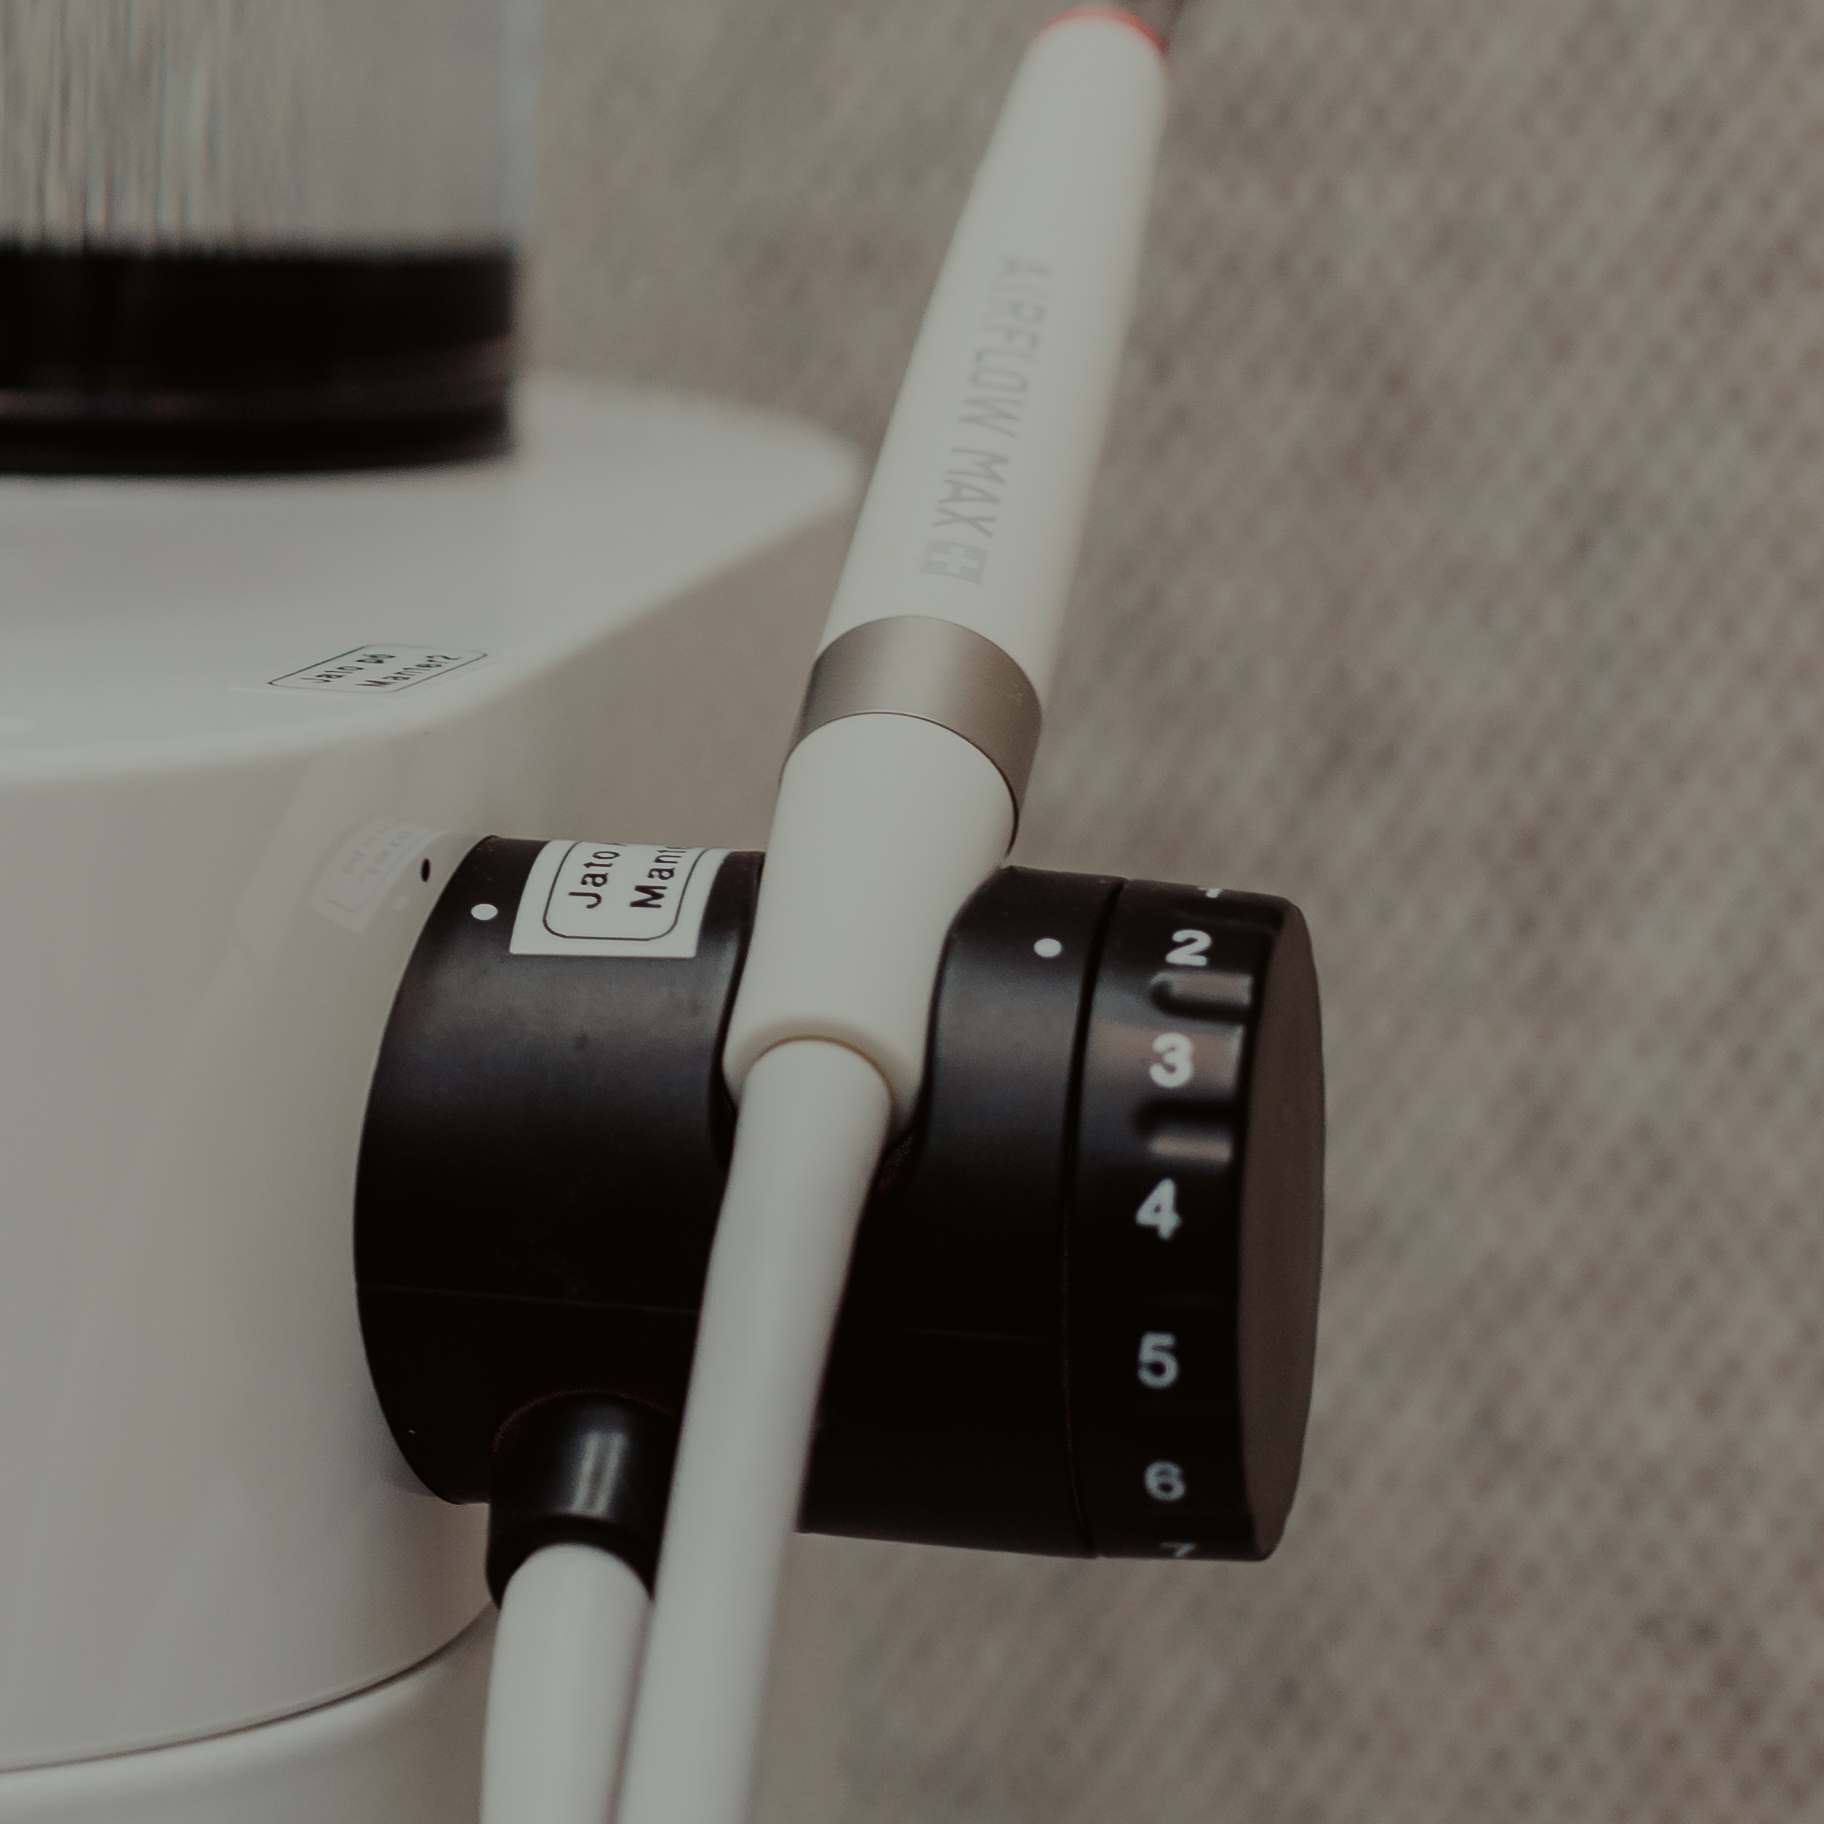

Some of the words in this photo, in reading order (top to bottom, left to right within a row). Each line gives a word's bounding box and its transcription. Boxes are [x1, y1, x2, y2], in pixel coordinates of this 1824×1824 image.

[959, 256, 1052, 439] AIRFLOW
[931, 447, 1011, 540] MAX
[568, 850, 621, 909] Jato
[629, 845, 694, 909] Mant
[1165, 928, 1212, 967] 2
[1150, 1032, 1194, 1087] 3
[1136, 1178, 1181, 1238] 4
[1138, 1332, 1179, 1388] 5
[1144, 1461, 1186, 1501] 6
